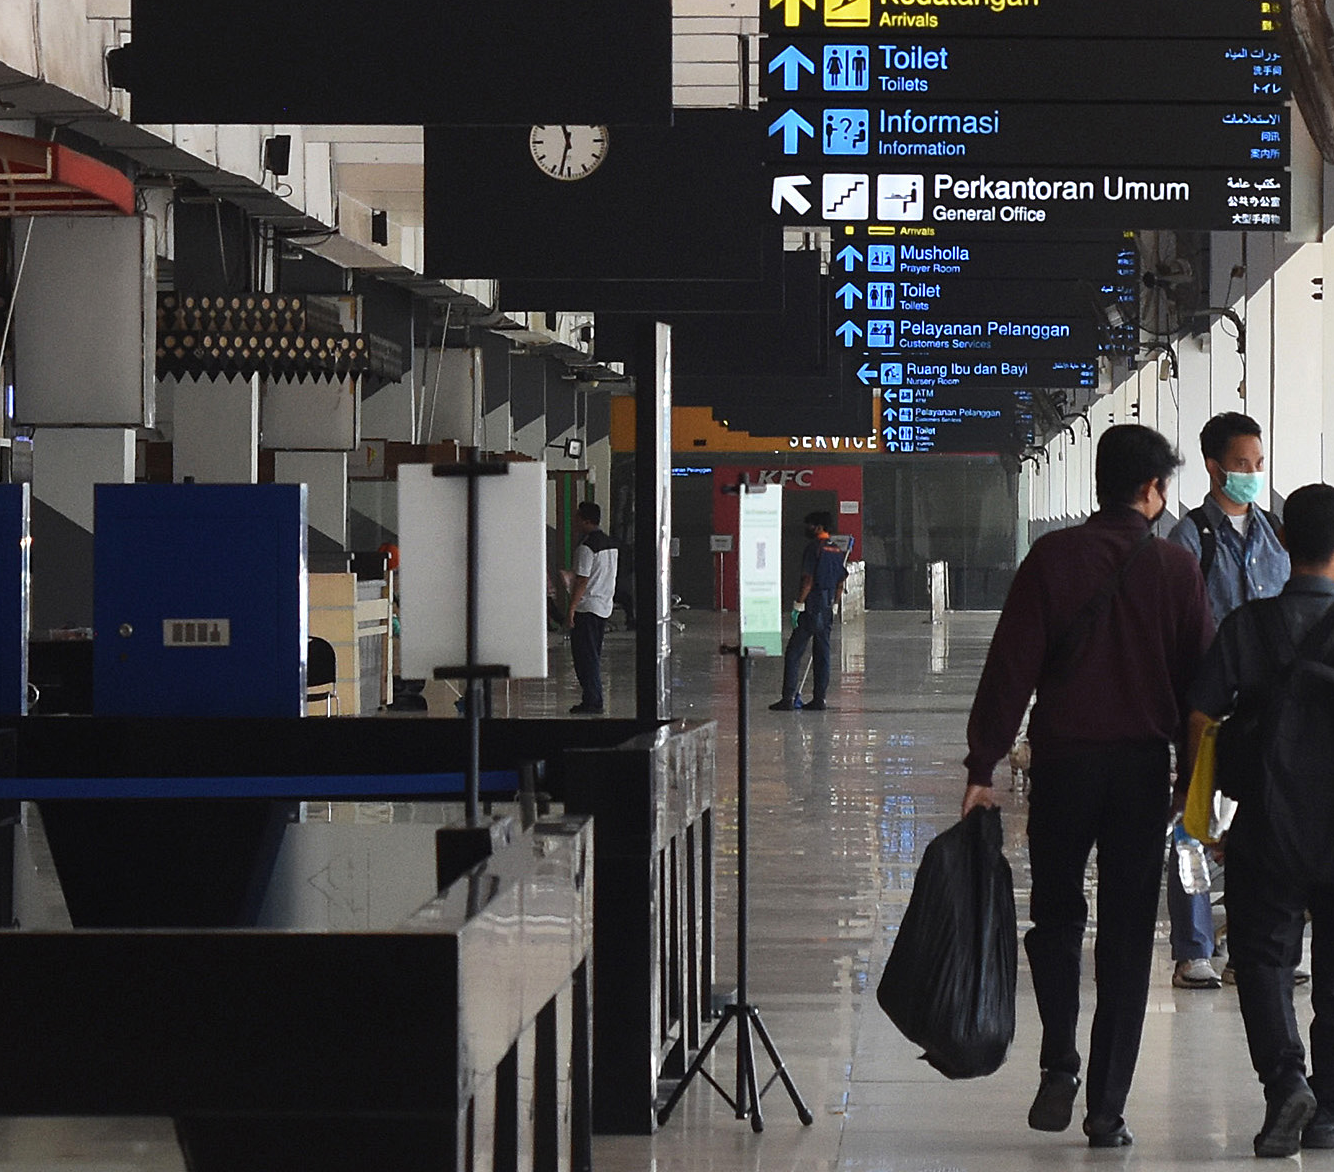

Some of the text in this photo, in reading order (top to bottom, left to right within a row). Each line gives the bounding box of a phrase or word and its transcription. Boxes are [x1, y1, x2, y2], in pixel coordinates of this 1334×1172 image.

[879, 11, 939, 28] Arrivals
[878, 45, 949, 70] Toilet
[878, 75, 929, 92] Toilets
[1253, 82, 1282, 94] トイレ
[879, 108, 999, 135] Informasi
[878, 140, 966, 156] Information
[934, 174, 1190, 201] Perkantoran Umum
[932, 205, 1046, 222] General Office
[899, 226, 936, 236] Arrivals
[900, 244, 970, 261] Musholla
[899, 263, 961, 274] Prayer Room
[899, 282, 941, 298] Toilet
[899, 301, 930, 311] Toilets
[900, 320, 1070, 340] Pelayanan Pelanggan
[898, 338, 991, 349] Customers Services
[906, 362, 1028, 378] Ruang Ibu dan Bayi
[914, 388, 934, 397] ATM
[915, 407, 1001, 419] Pelayanan Pelanggan
[758, 469, 814, 488] KFC
